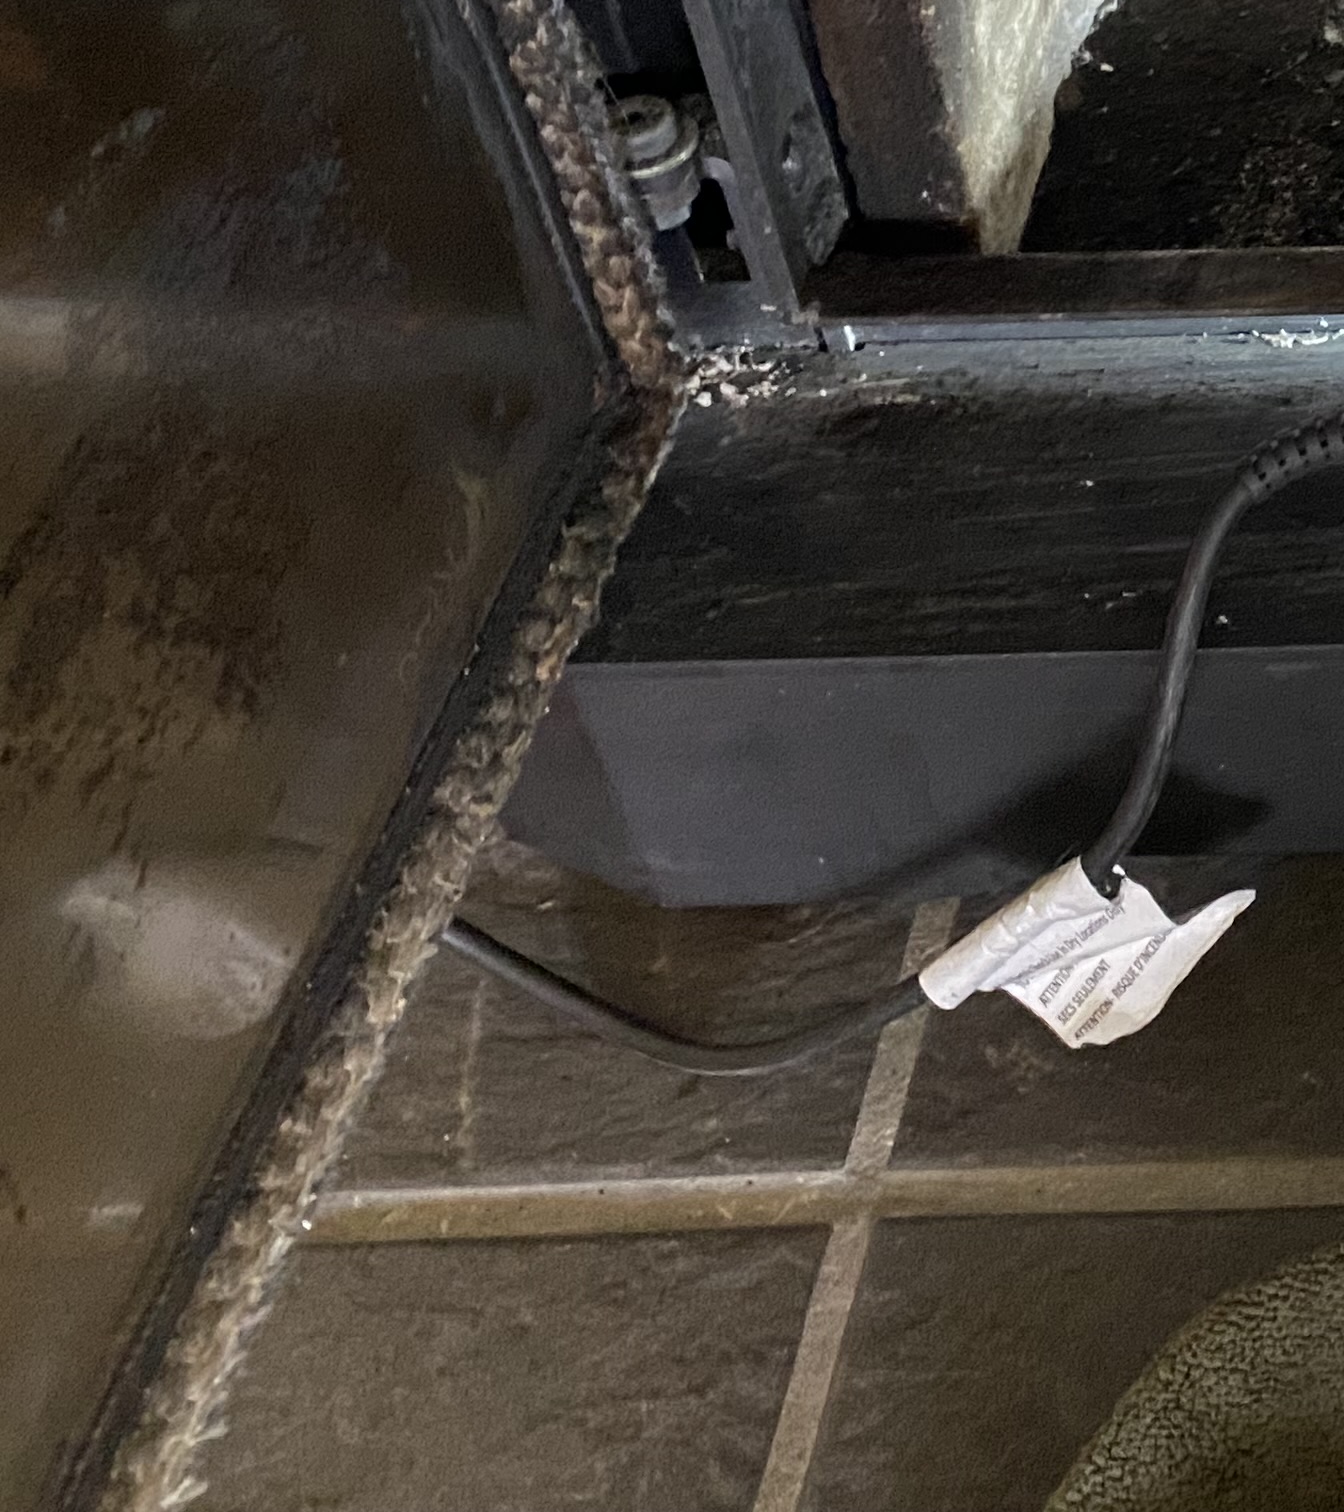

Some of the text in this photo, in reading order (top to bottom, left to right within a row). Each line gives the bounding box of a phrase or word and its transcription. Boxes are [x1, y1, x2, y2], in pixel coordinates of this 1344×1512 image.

[1077, 914, 1110, 942] Locations
[1056, 957, 1112, 1027] SECS SEULEMENT
[1110, 965, 1141, 1001] RISQUE
